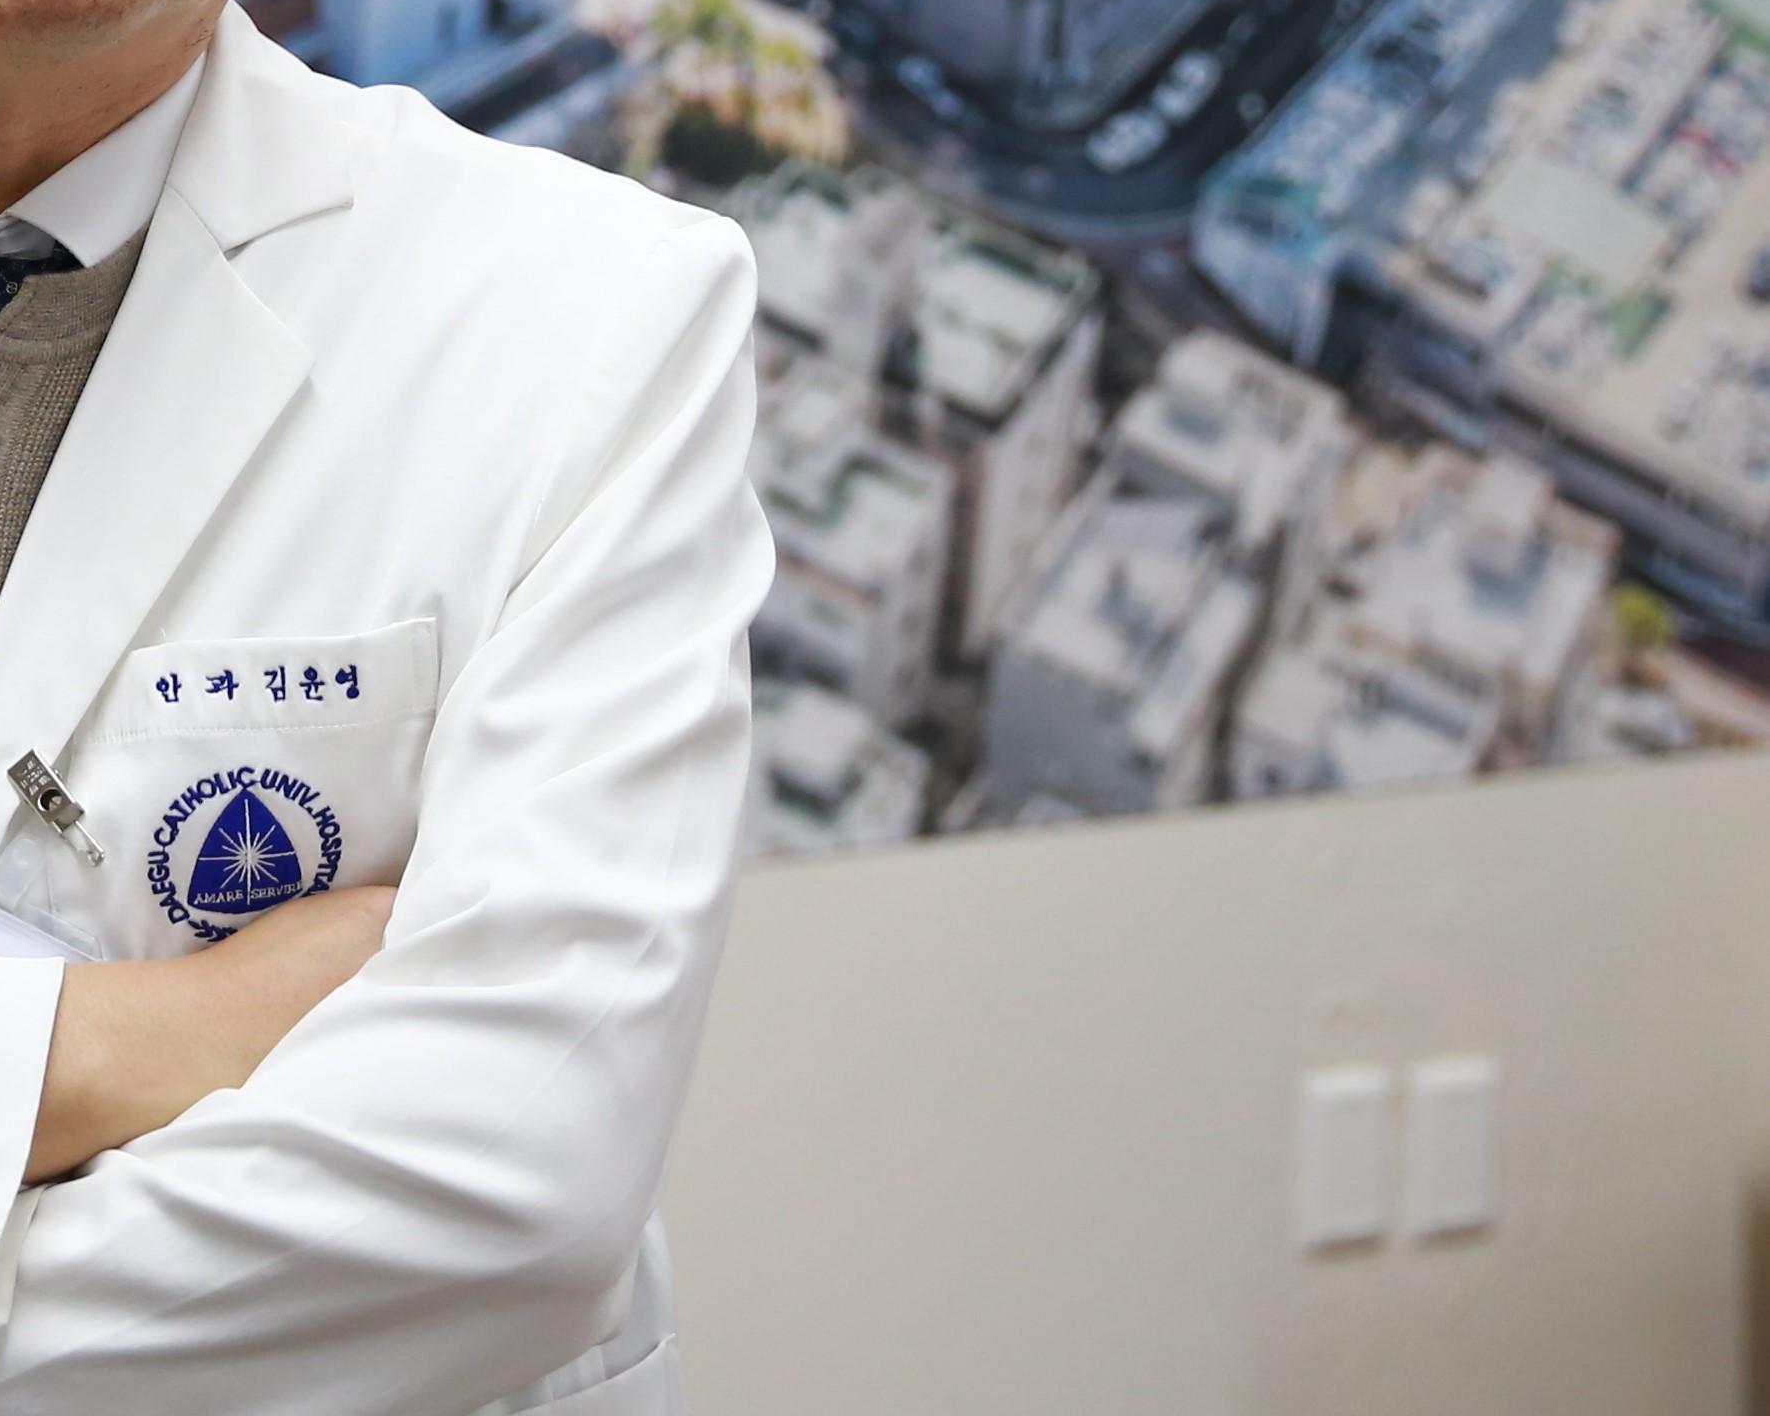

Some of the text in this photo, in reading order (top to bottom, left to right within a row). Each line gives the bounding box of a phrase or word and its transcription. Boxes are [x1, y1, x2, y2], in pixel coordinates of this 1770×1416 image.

[263, 664, 360, 702] 김윤영
[153, 766, 256, 847] CATHOLIC
[147, 851, 191, 924] DAEGU
[193, 889, 244, 905] AMARE
